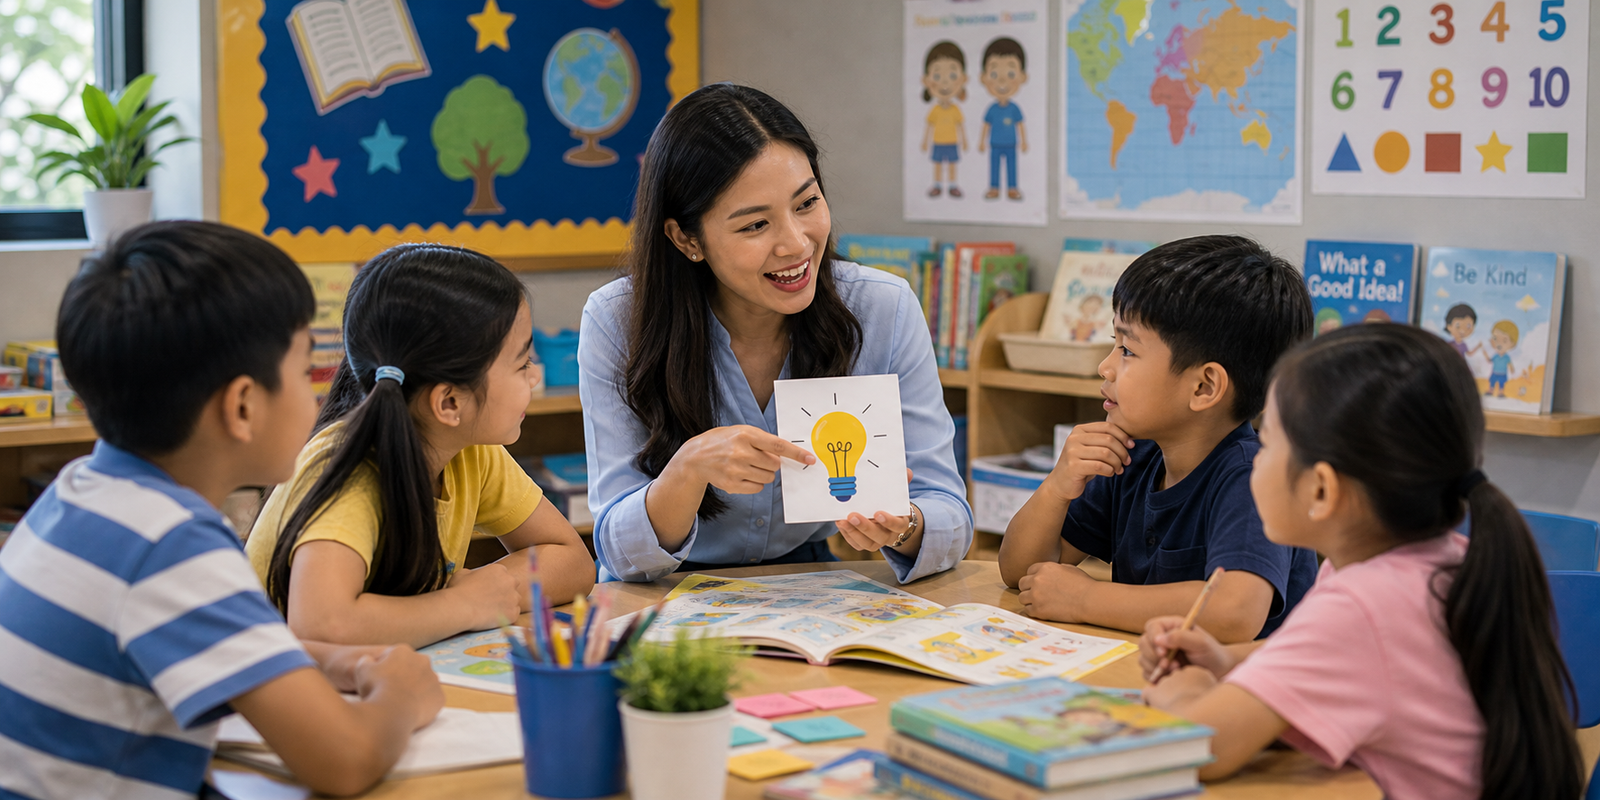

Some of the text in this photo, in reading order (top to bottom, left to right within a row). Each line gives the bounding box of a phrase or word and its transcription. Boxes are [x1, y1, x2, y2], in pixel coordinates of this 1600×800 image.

[1335, 0, 1567, 47] 1 2 3 4 5
[1331, 66, 1570, 110] 6 7 8 9 10
[1319, 251, 1386, 277] What a
[1454, 262, 1528, 286] Be Kind
[1308, 274, 1404, 303] Good Idea!
